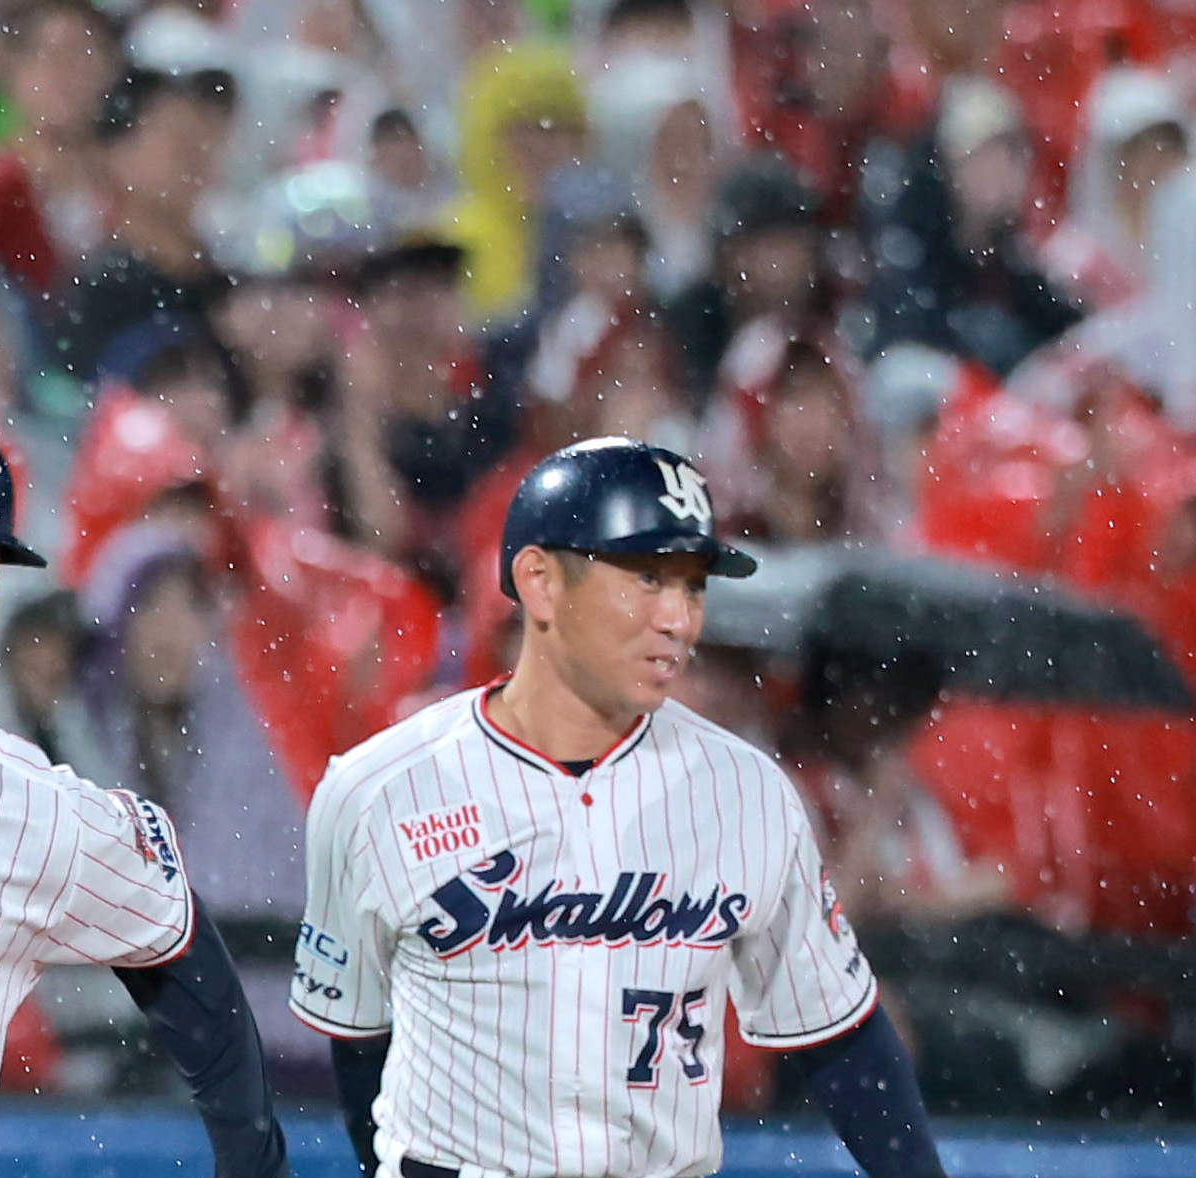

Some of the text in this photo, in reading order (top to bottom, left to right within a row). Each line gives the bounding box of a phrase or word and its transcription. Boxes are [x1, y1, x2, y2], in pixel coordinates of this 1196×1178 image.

[398, 804, 482, 841] Yakult
[411, 827, 481, 861] 1000
[416, 849, 752, 961] Swallows
[621, 986, 709, 1090] 75
